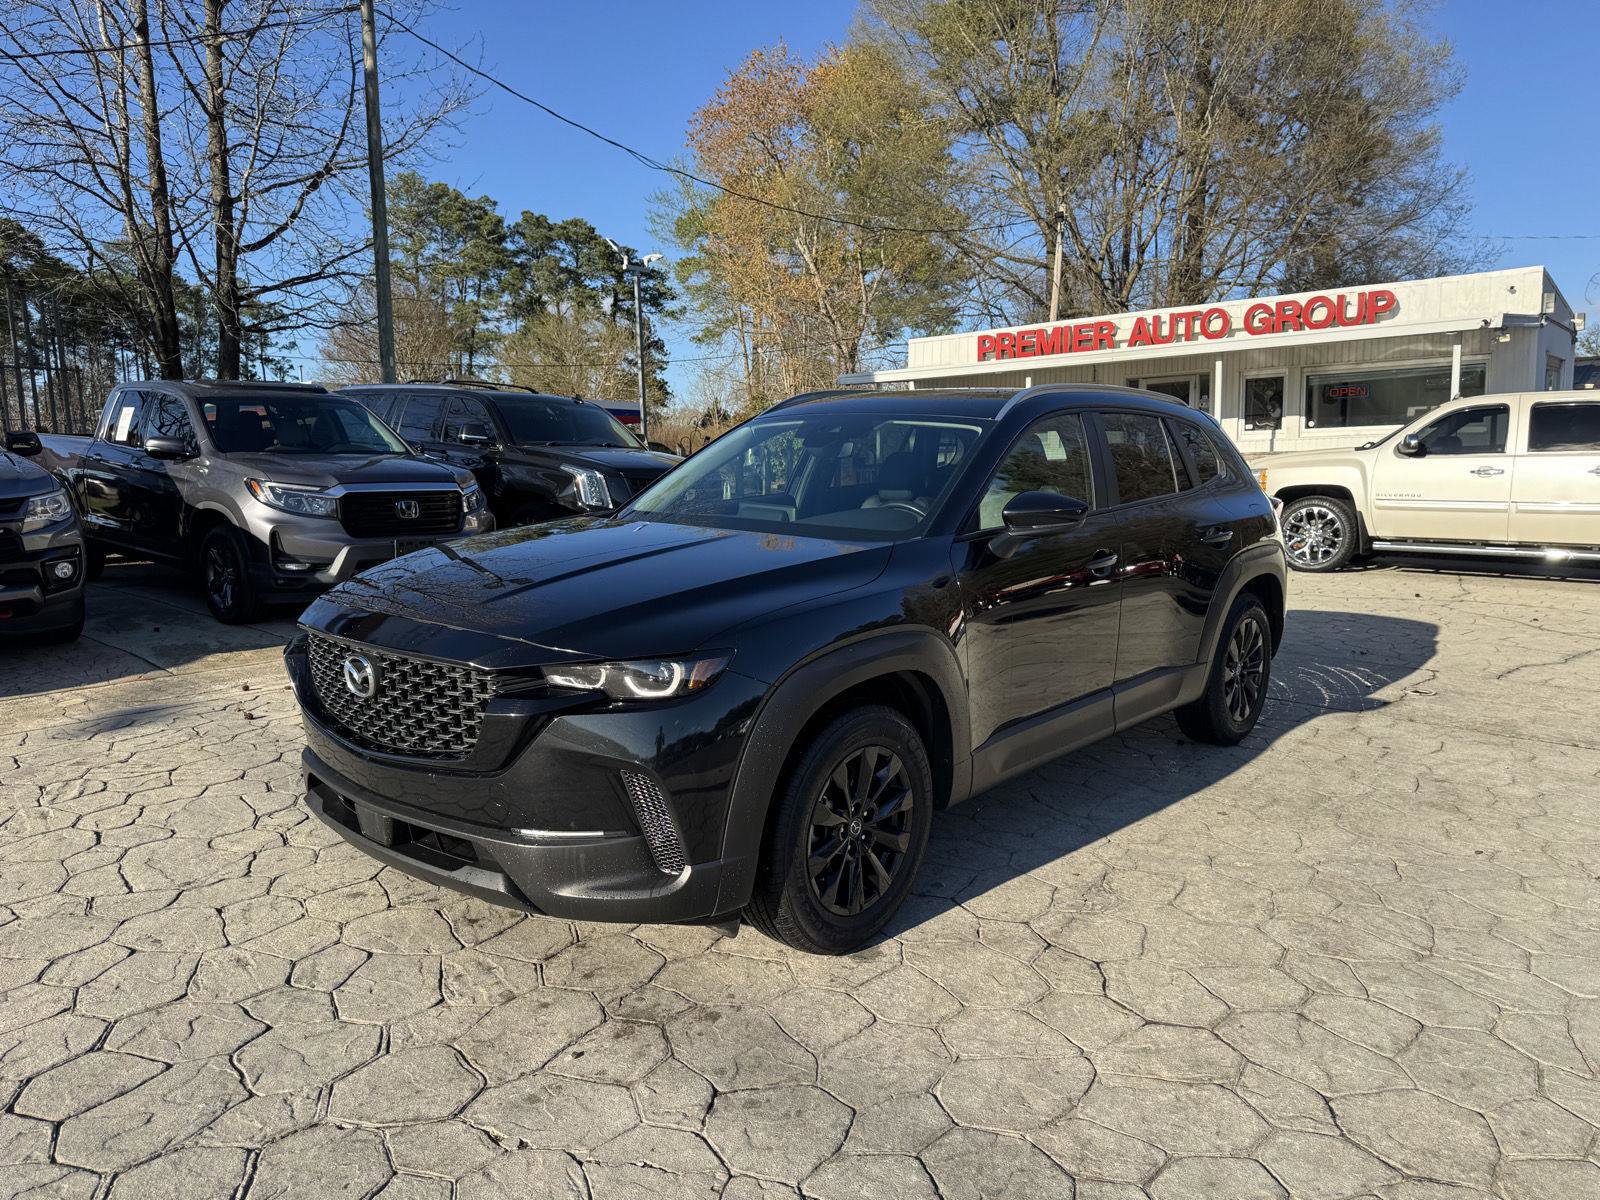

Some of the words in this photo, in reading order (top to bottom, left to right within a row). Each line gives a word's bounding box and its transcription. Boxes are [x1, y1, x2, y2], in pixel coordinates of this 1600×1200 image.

[978, 320, 1115, 361] PREMIER
[1128, 308, 1230, 347] AUTO
[1244, 290, 1397, 335] GROUP
[1329, 387, 1368, 397] OPEN
